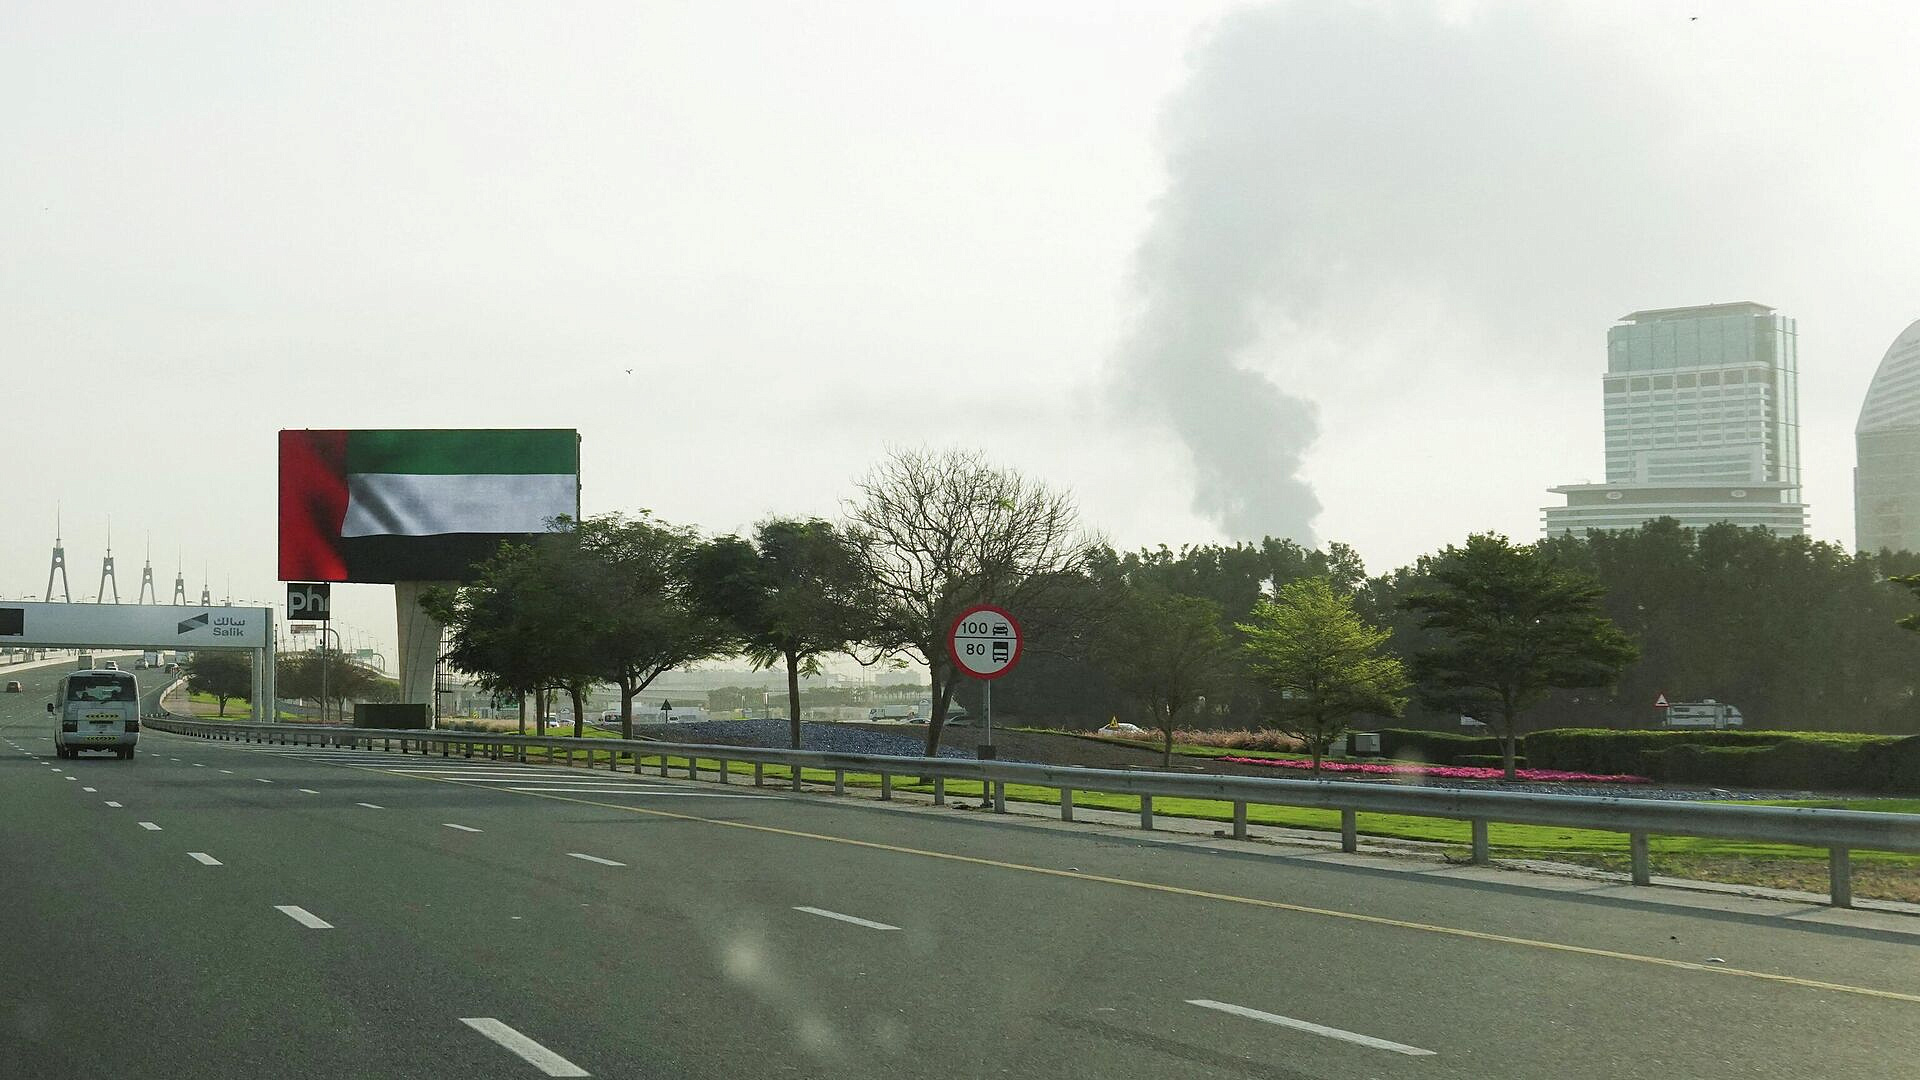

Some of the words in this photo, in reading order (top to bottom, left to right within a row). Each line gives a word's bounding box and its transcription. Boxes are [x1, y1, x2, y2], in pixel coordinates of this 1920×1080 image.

[214, 617, 245, 626] سالك
[213, 627, 244, 636] Salik
[962, 622, 988, 634] 100
[966, 643, 985, 655] 80
